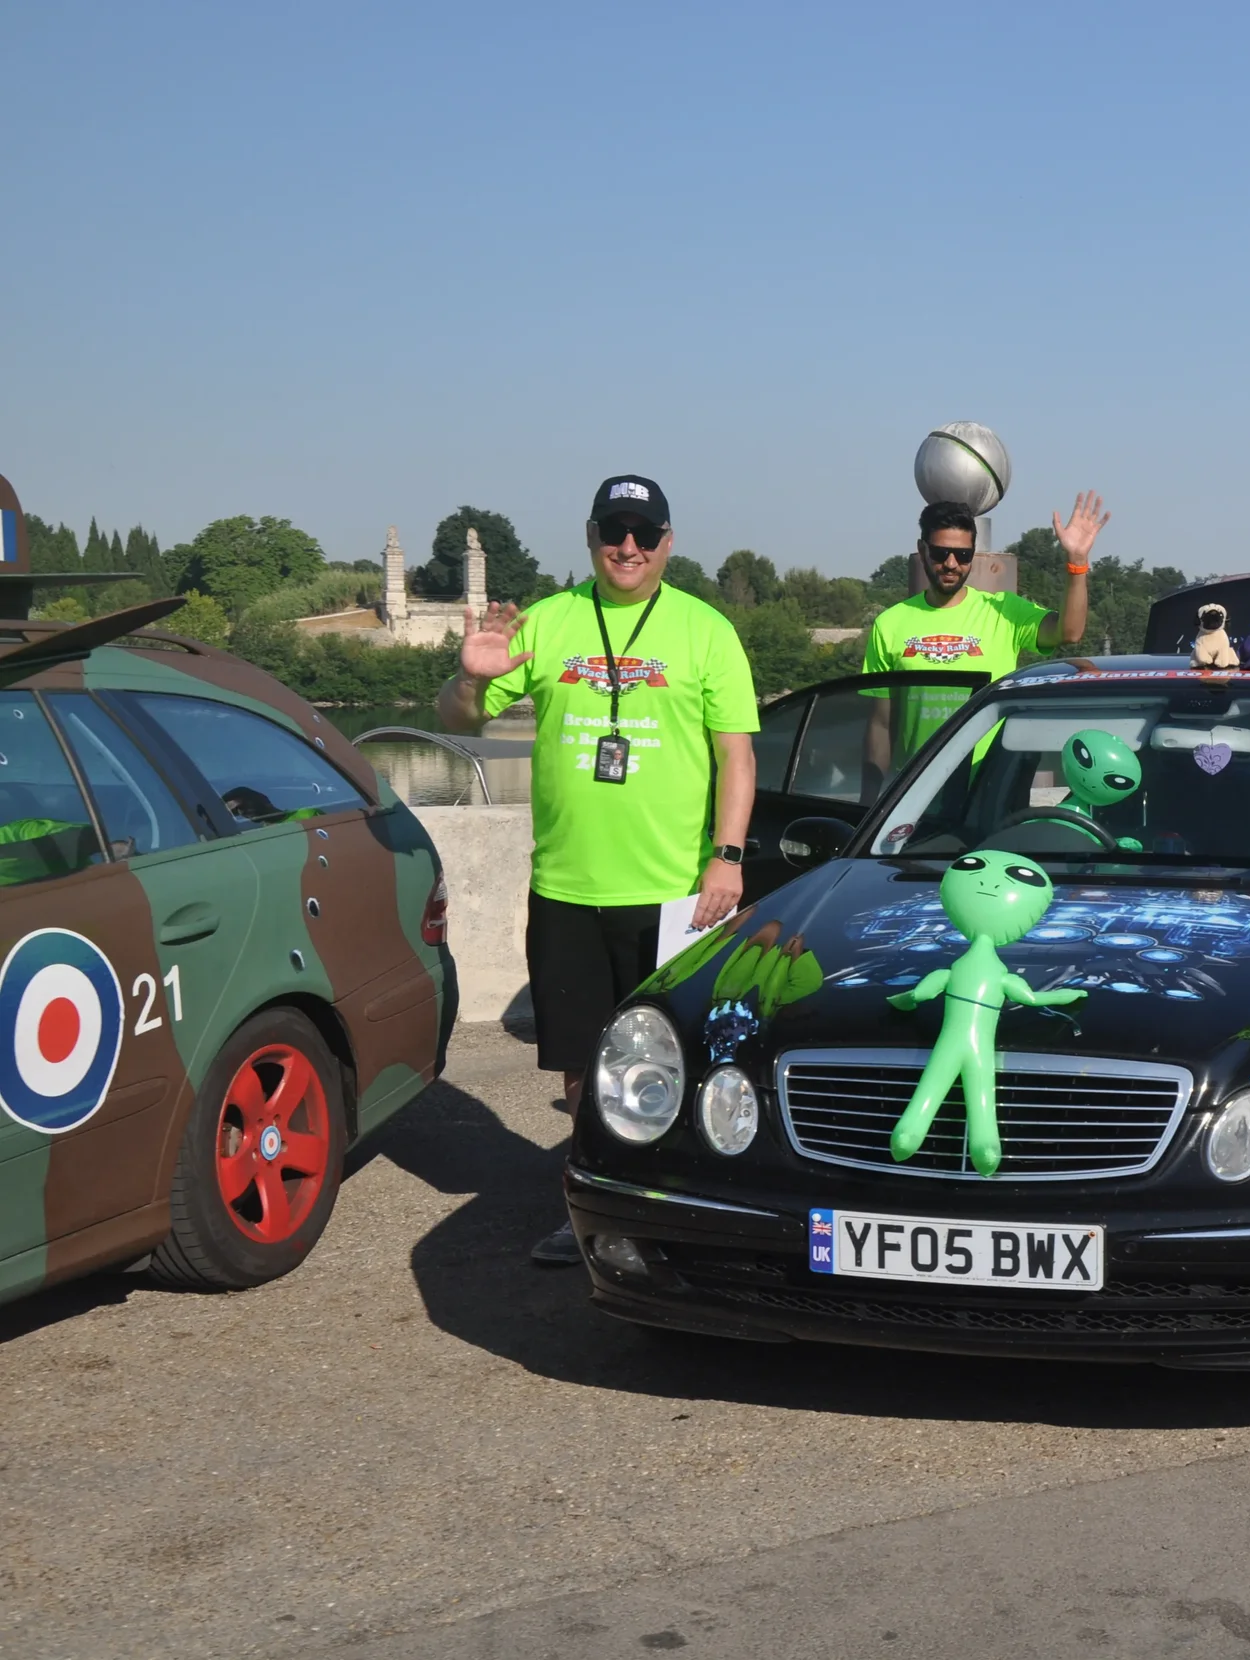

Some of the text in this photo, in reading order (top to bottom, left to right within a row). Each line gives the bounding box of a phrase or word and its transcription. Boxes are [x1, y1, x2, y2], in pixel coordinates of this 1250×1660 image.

[914, 644, 970, 652] Wacky Rally
[577, 666, 651, 679] Wack Rally
[564, 713, 659, 729] Brookands
[576, 753, 640, 774] 25
[132, 964, 182, 1036] 21
[813, 1245, 831, 1263] UK
[844, 1221, 1092, 1281] YF05 BWX
